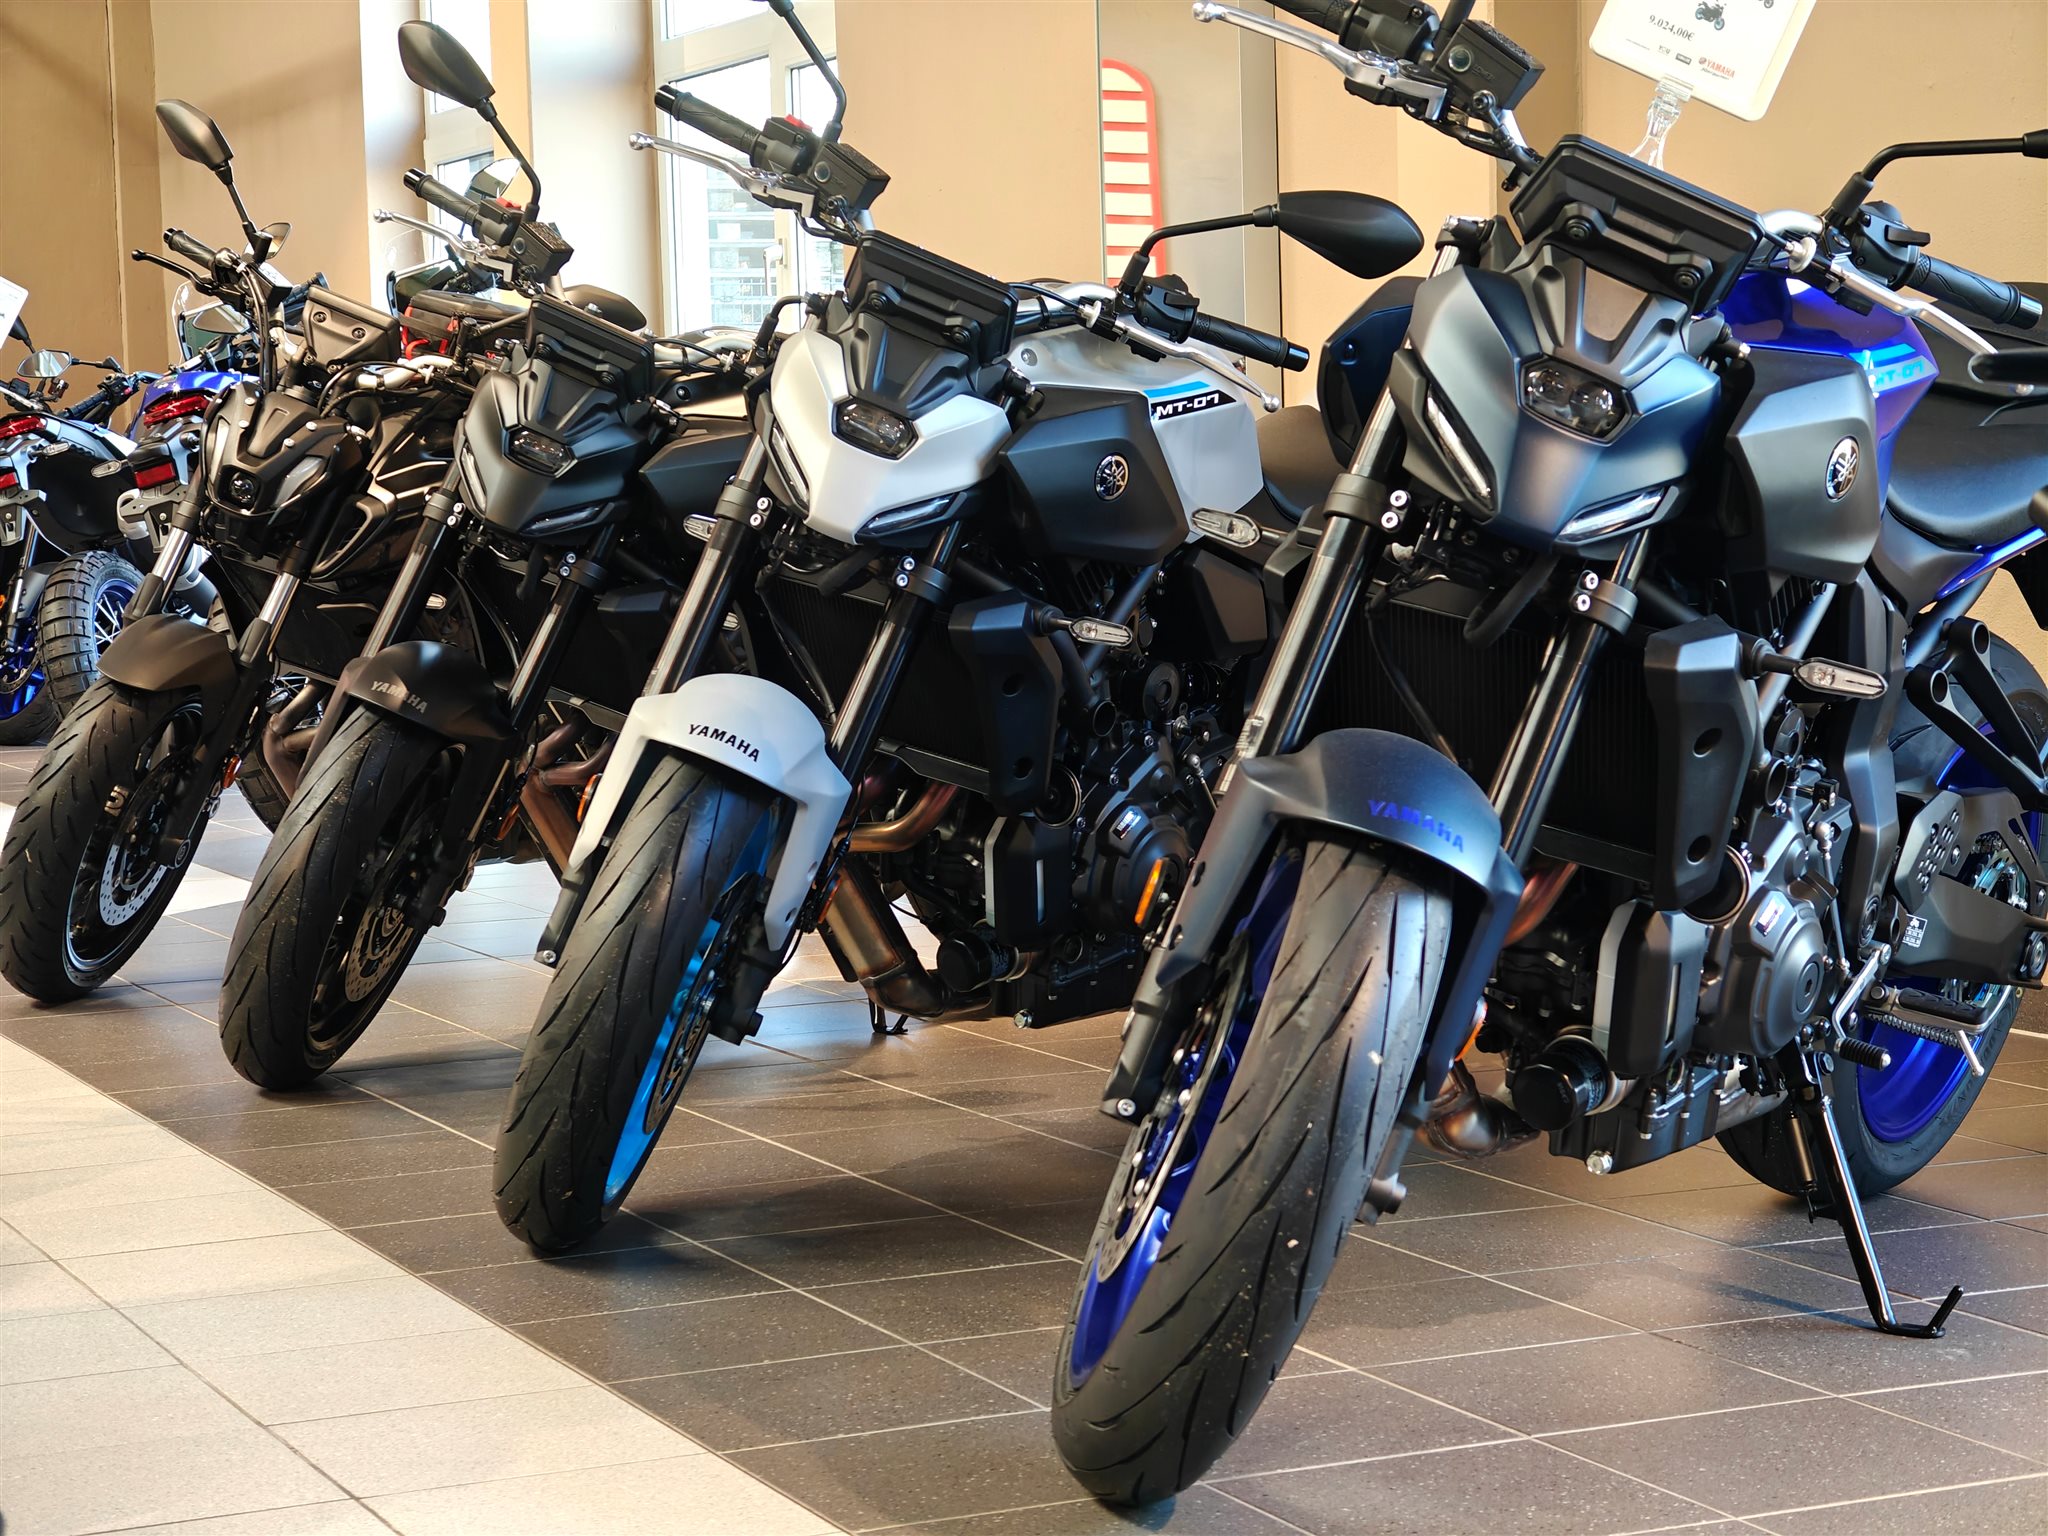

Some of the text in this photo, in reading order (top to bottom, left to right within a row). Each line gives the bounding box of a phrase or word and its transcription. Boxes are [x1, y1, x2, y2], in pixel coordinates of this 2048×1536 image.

[1649, 15, 1695, 41] 9.024,00€
[1706, 59, 1736, 78] YAMAHA
[1156, 393, 1220, 417] MT-07
[371, 681, 428, 714] YAMAHA
[688, 723, 760, 763] YAMAHA
[1368, 799, 1464, 854] YAMAHA
